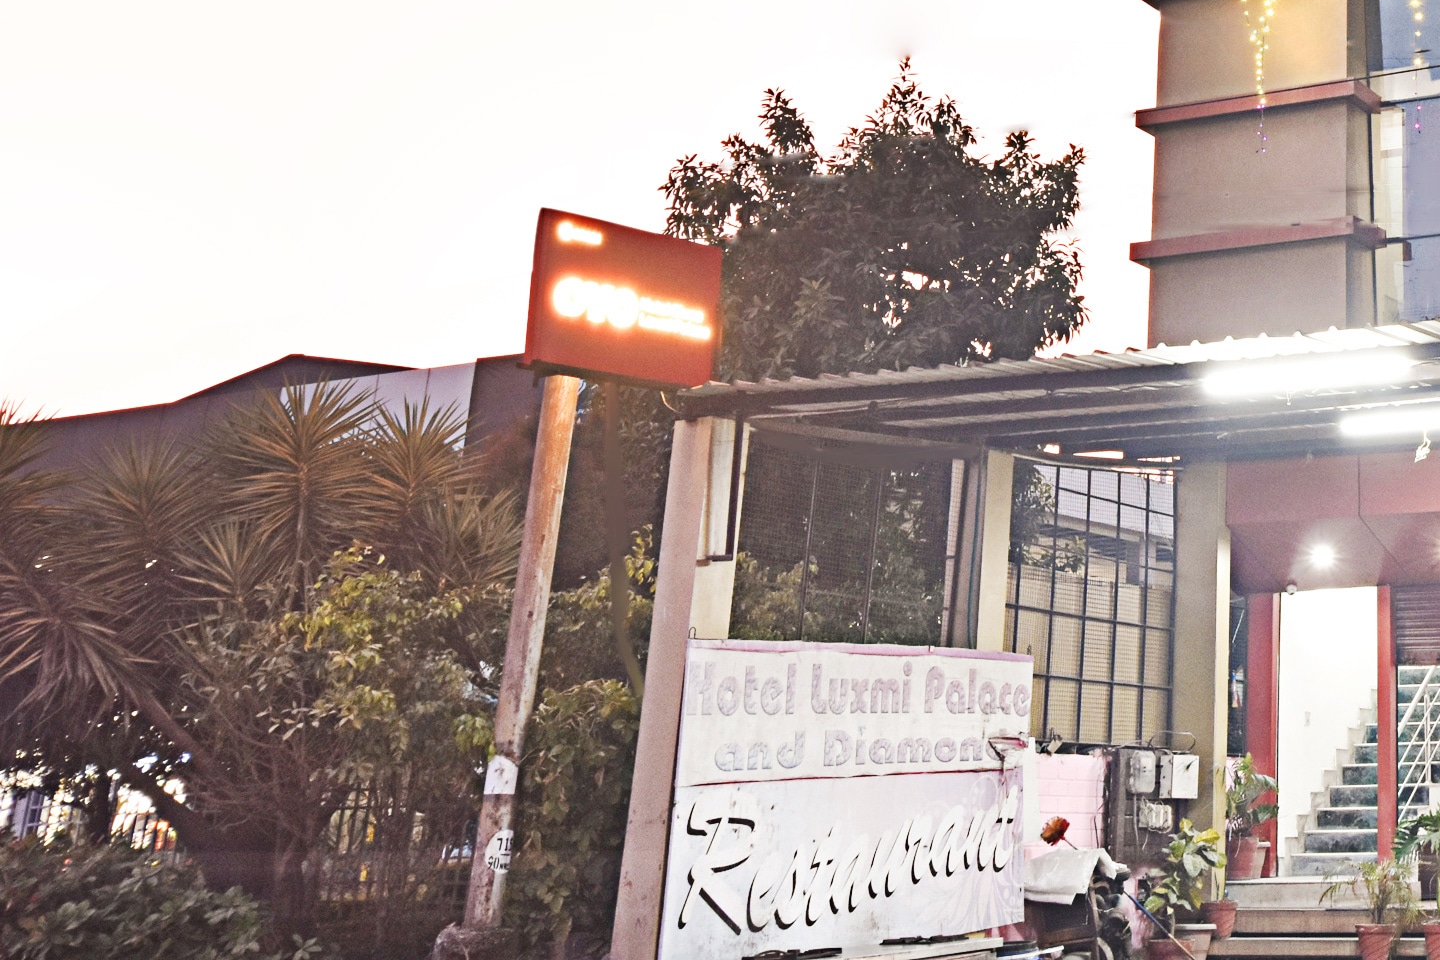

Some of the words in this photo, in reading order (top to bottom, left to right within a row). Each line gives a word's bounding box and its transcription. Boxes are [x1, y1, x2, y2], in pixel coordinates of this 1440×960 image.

[685, 660, 797, 717] Hotel
[810, 661, 914, 715] Luxmi
[924, 665, 1031, 717] Palace
[714, 729, 807, 772] and
[677, 787, 1019, 936] Restaurant
